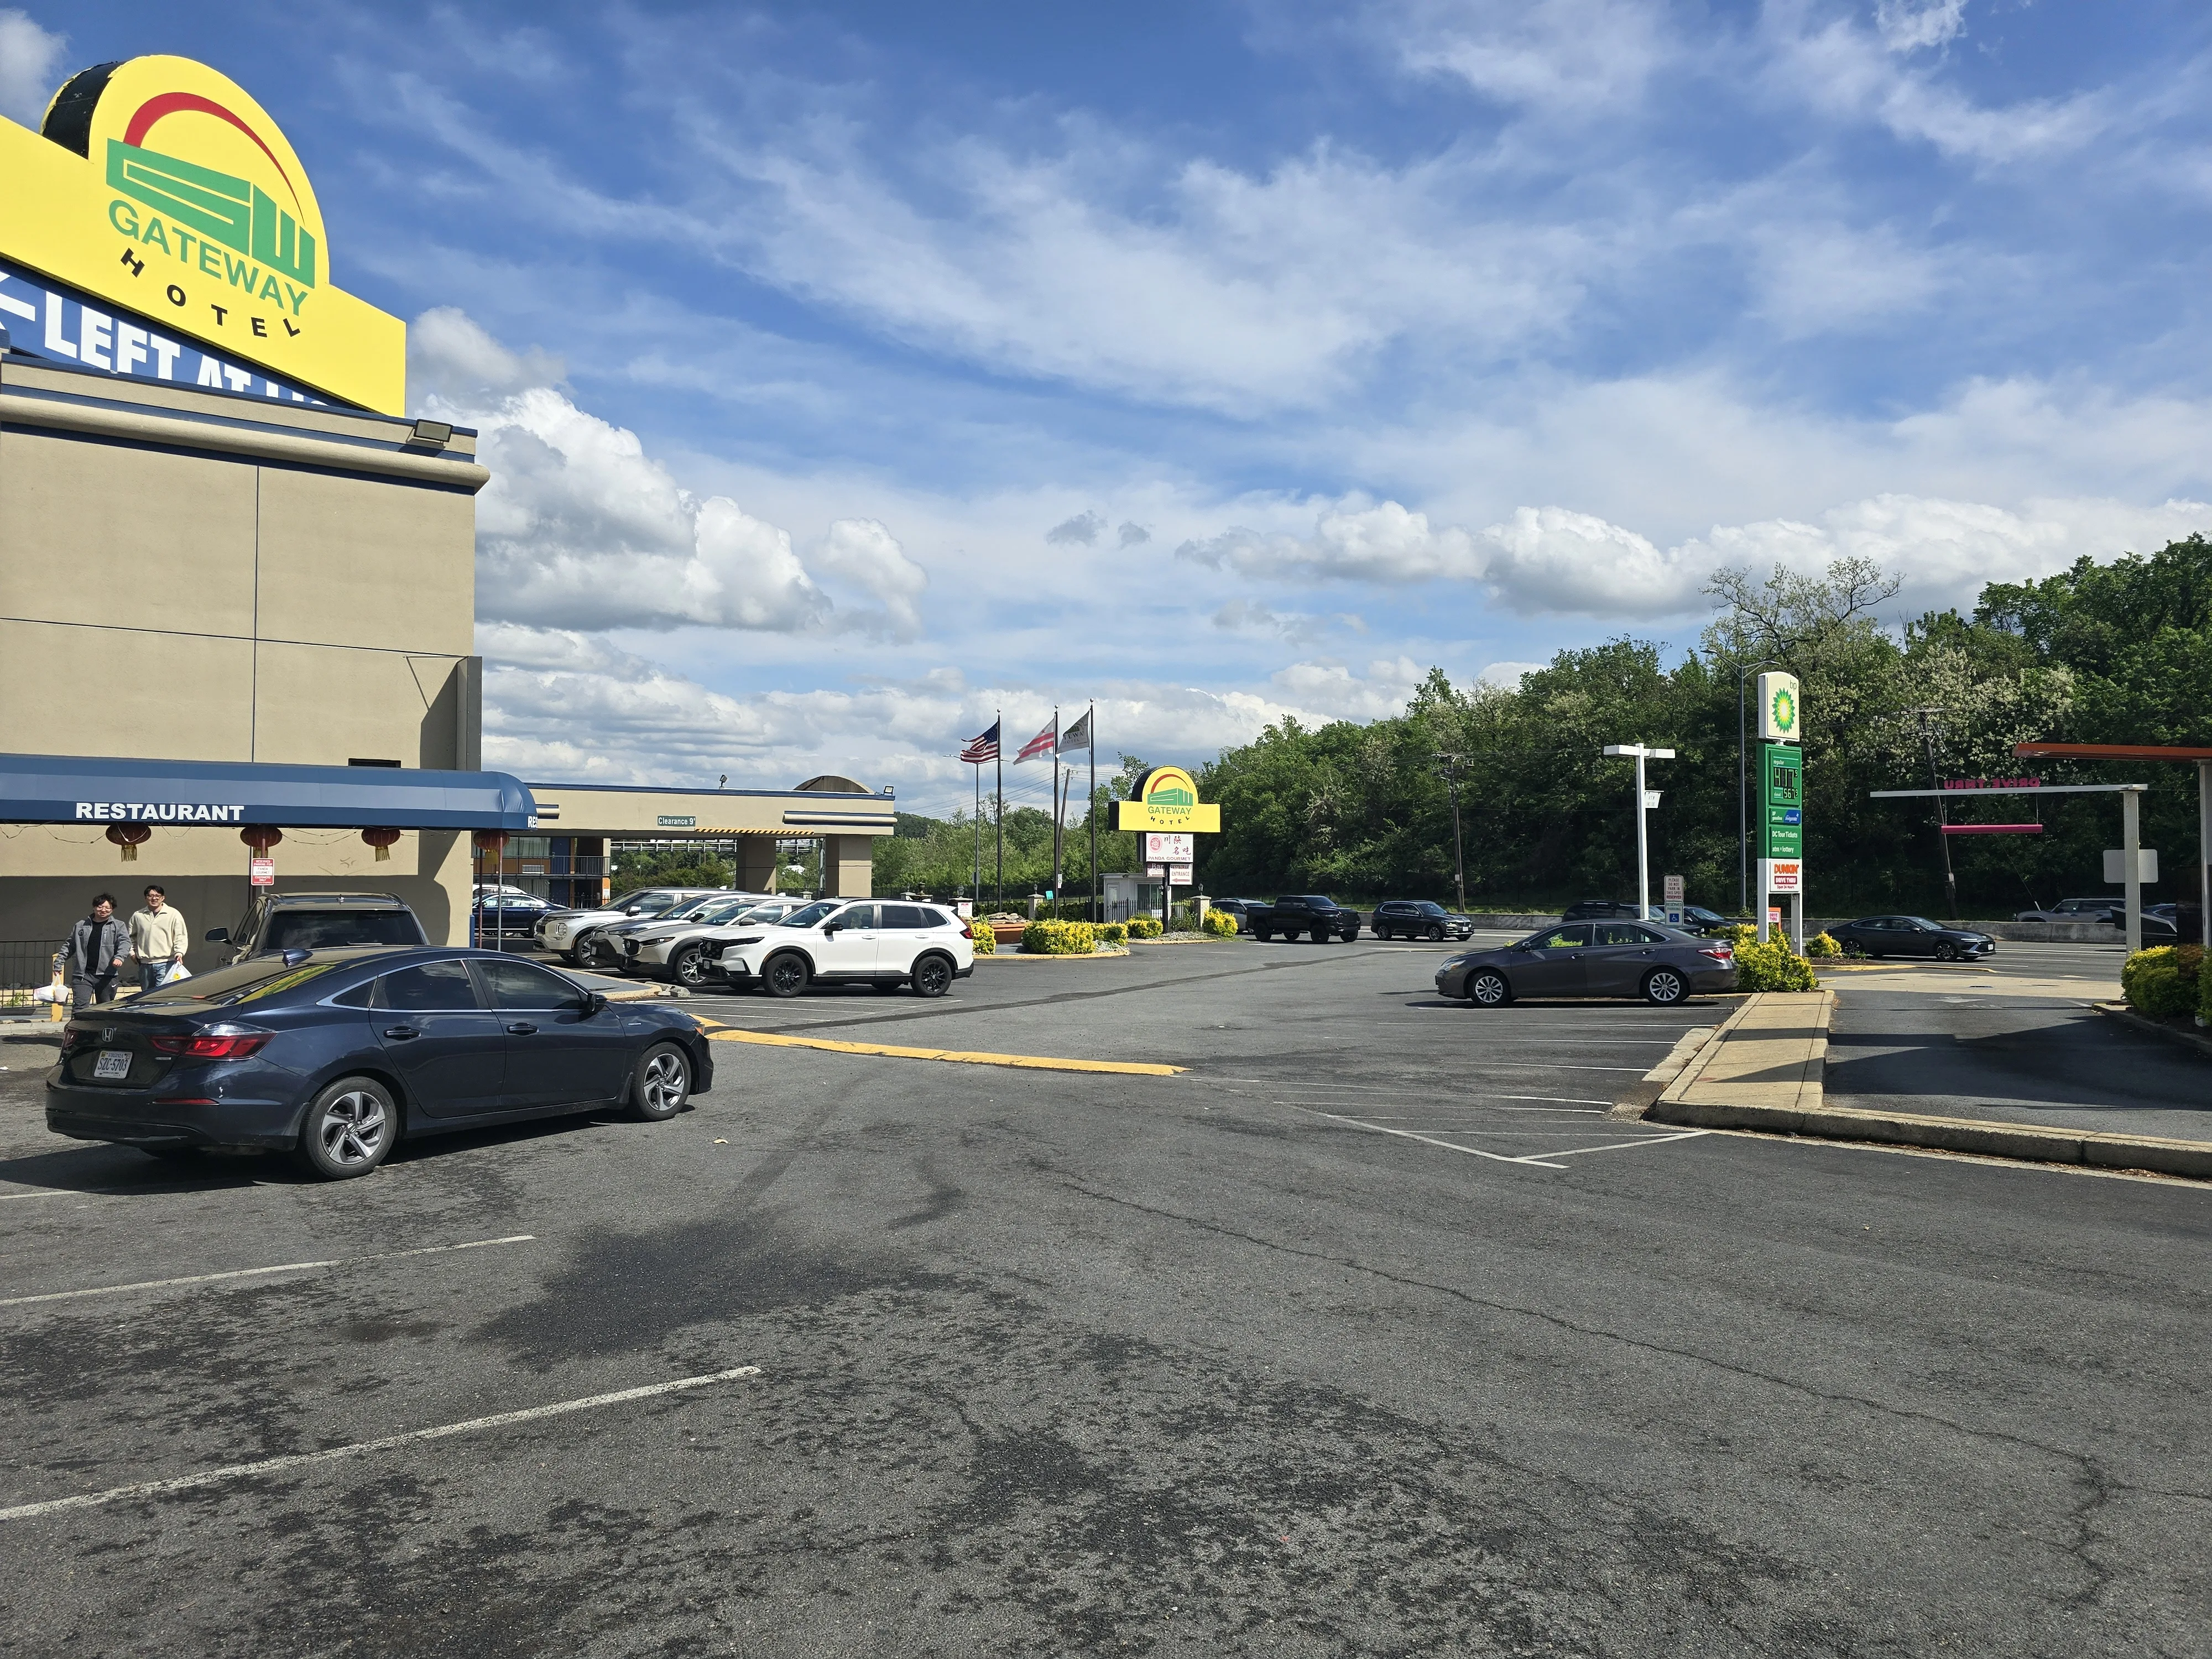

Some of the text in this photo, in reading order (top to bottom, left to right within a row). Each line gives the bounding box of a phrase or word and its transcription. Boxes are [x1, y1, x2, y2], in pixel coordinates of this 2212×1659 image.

[109, 200, 308, 316] GATEWAY
[121, 248, 301, 337] HOTEL
[1790, 679, 1797, 691] bp
[76, 802, 244, 821] RESTAURANT
[1147, 806, 1192, 815] GATEWAY
[658, 817, 688, 825] Clearance
[1150, 816, 1190, 825] HOTEL
[1782, 846, 1794, 854] lottery
